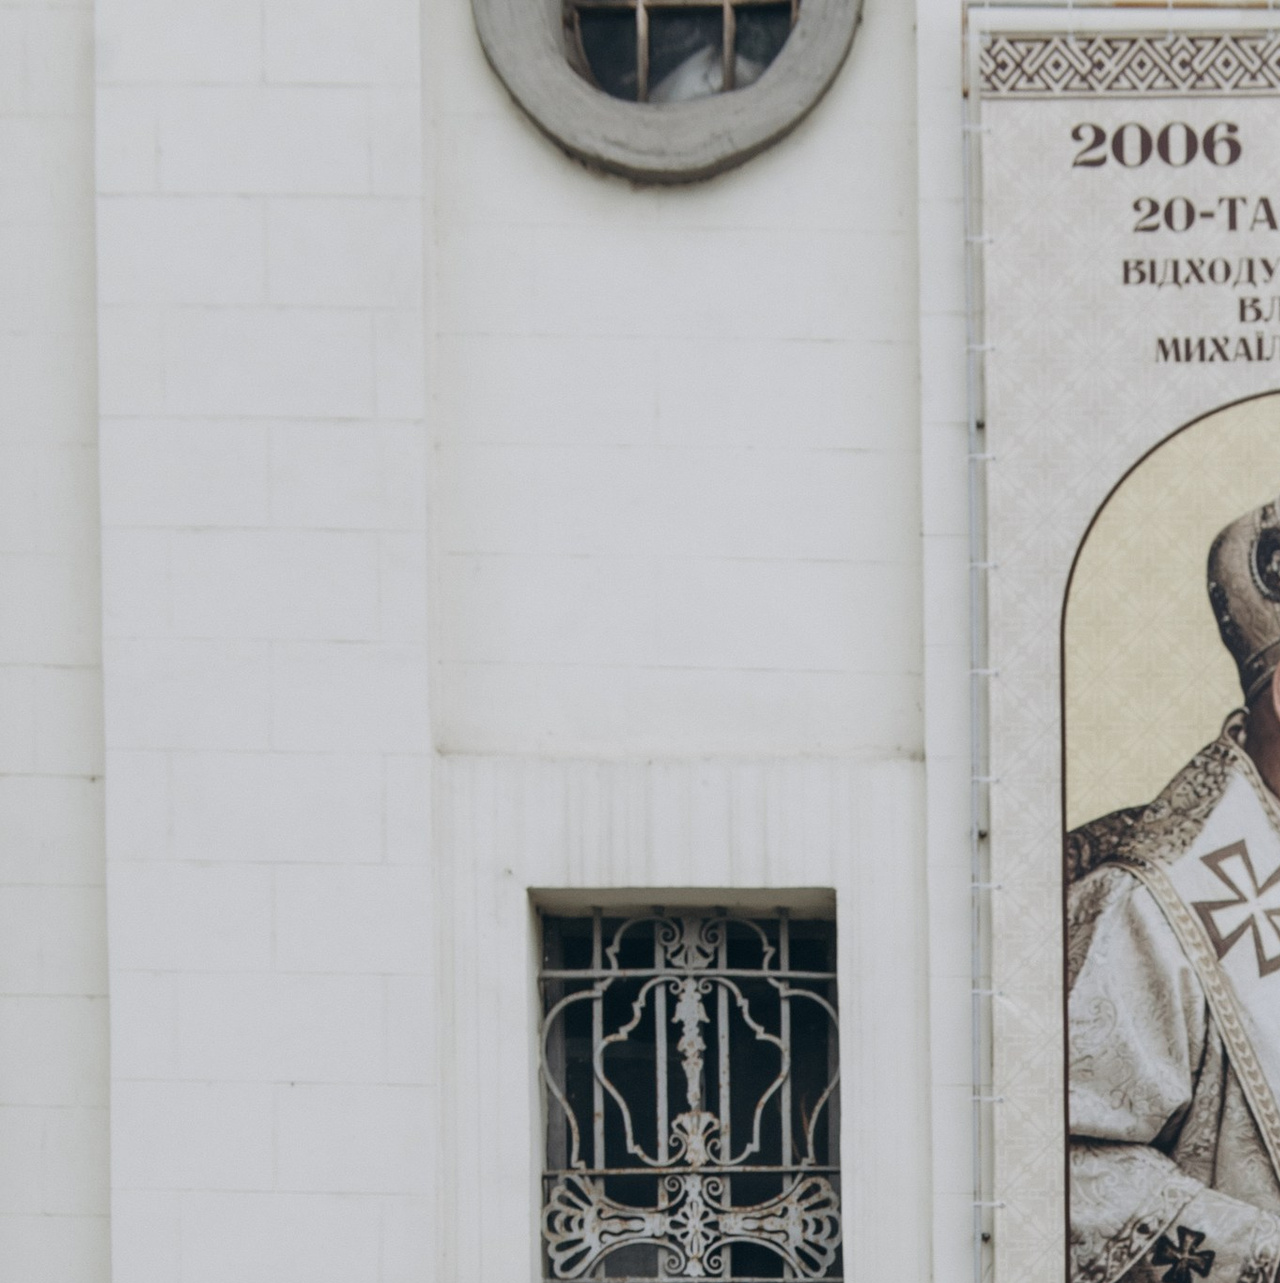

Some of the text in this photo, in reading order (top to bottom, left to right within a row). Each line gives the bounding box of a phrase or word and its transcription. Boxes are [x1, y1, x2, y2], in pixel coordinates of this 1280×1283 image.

[1070, 121, 1243, 169] 2006
[1132, 196, 1279, 234] 20-ТА
[1122, 257, 1280, 289] ВІДХОДУ
